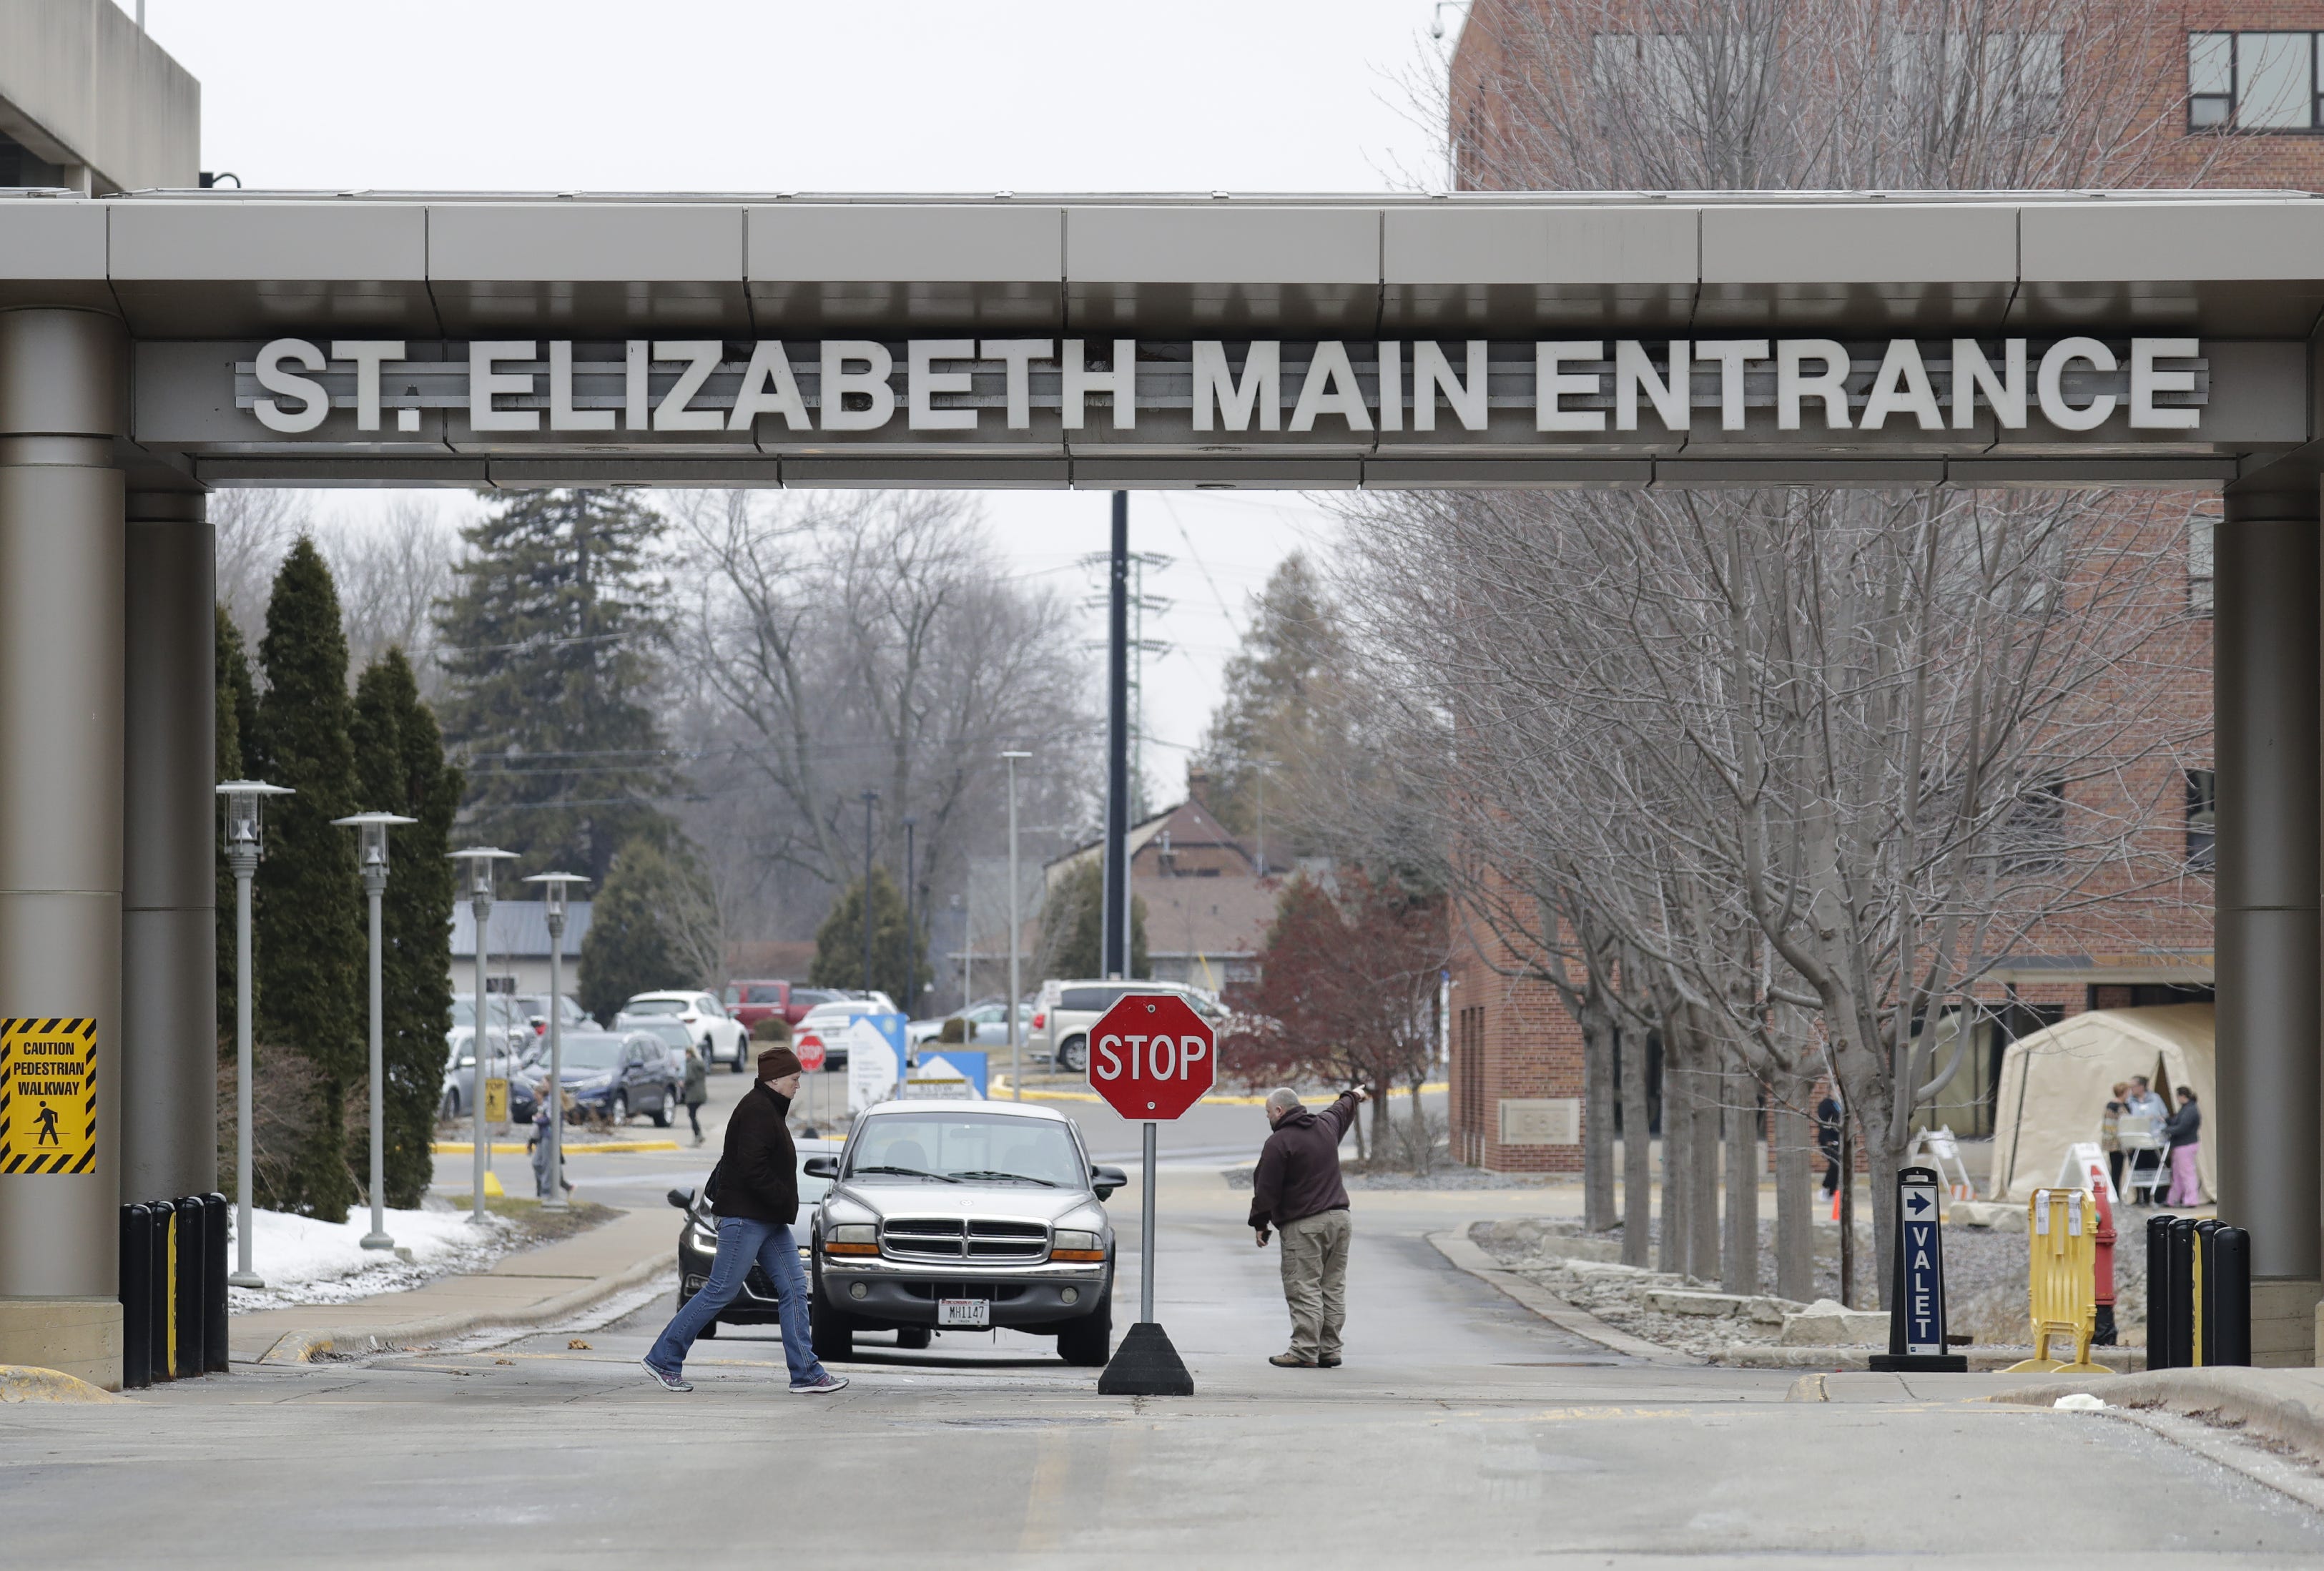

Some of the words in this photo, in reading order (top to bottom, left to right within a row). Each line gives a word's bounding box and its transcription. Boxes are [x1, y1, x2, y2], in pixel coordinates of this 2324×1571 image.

[253, 338, 420, 433] ST.
[468, 339, 1136, 430] ELIZABETH
[1192, 340, 1488, 431] MAIN
[1536, 337, 2200, 431] ENTRANCE
[24, 1042, 74, 1055] CAUTION
[799, 1045, 822, 1060] STOP
[1096, 1034, 1206, 1080] STOP
[14, 1062, 84, 1075] PEDESTRIAN
[18, 1081, 80, 1095] WALKWAY
[1912, 1227, 1931, 1338] VALET
[949, 1306, 985, 1318] MH1147
